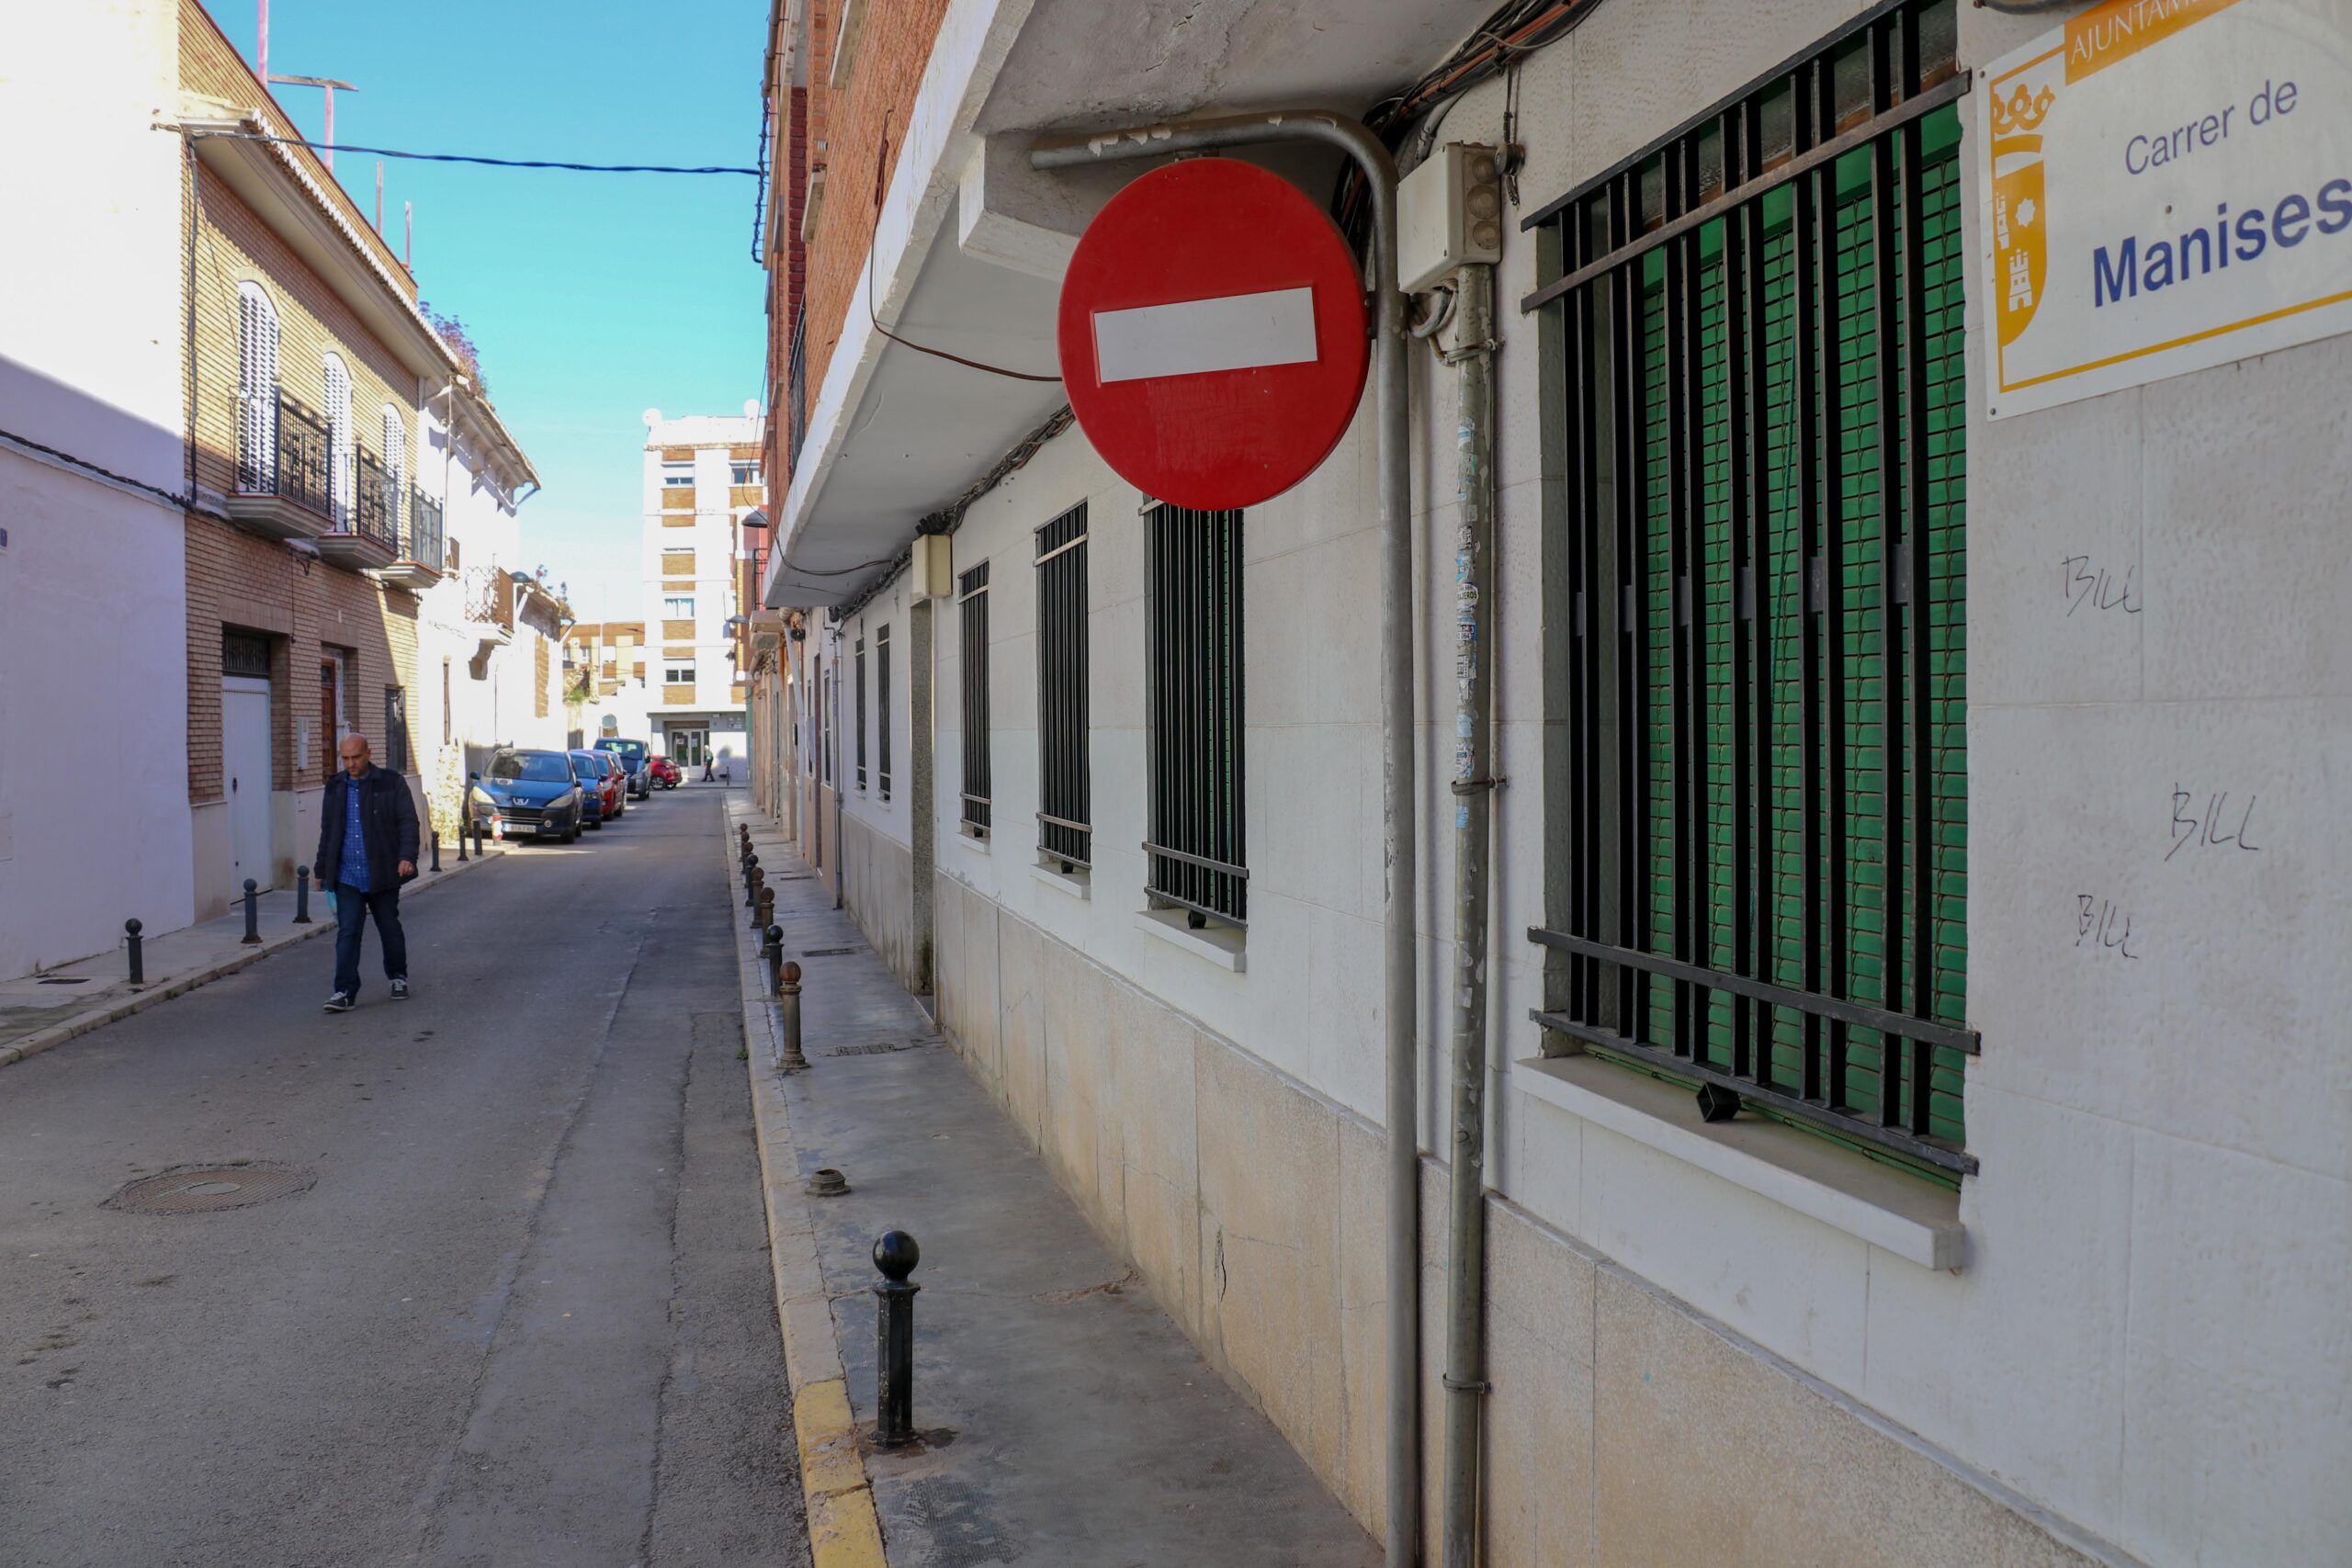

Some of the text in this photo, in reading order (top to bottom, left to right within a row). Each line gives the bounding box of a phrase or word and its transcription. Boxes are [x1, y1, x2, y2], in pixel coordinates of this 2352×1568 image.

[2125, 79, 2298, 175] Carrer de
[2093, 178, 2352, 309] Manises
[2062, 555, 2142, 617] BILL
[2164, 782, 2259, 862] BILL
[2076, 894, 2139, 959] BILL
